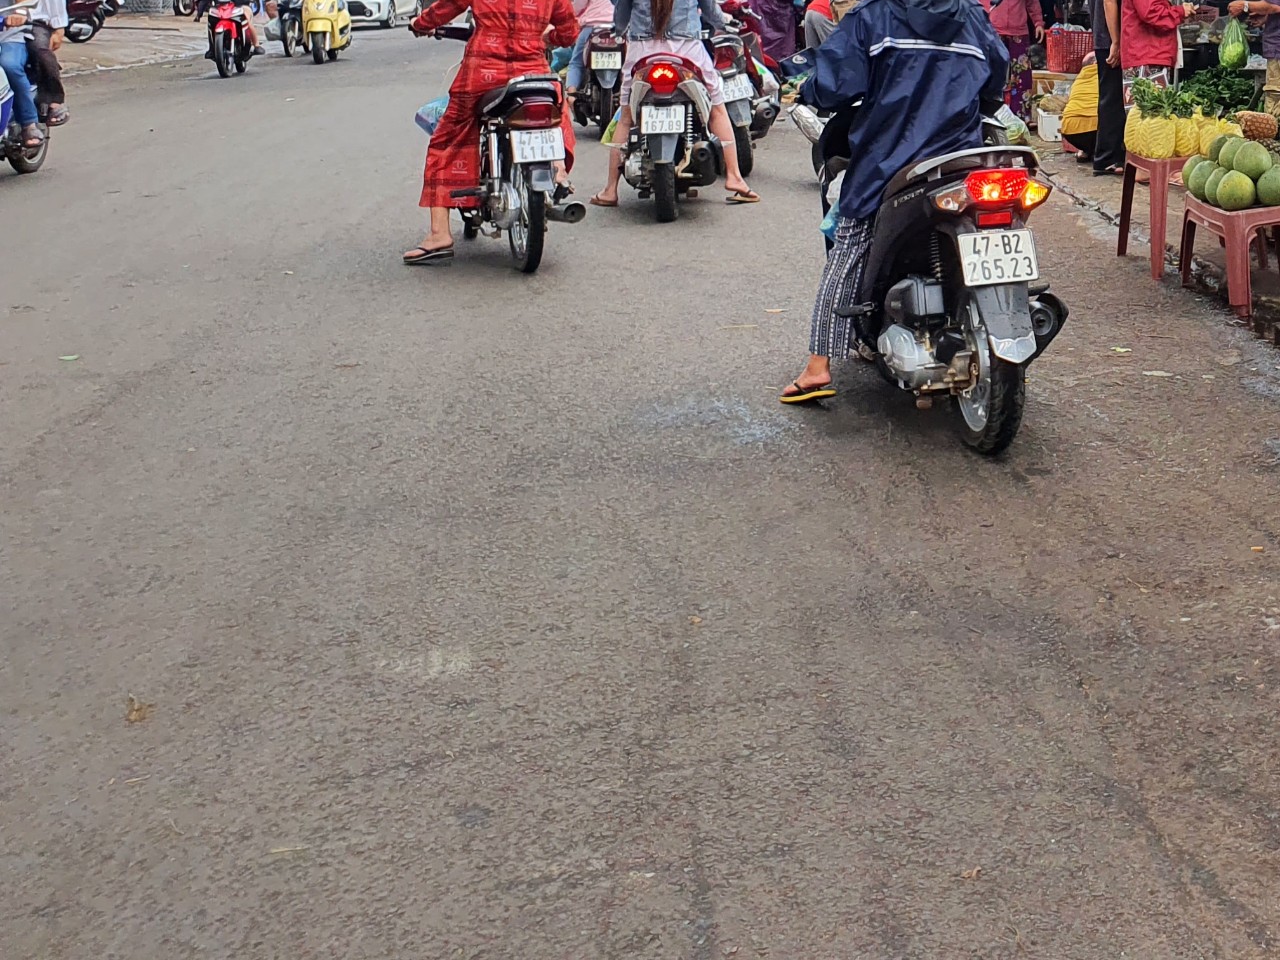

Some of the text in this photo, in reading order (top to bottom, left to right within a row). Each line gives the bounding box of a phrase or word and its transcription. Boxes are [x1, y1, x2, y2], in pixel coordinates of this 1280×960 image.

[645, 120, 682, 132] 167.89
[521, 145, 556, 160] 4141
[972, 234, 1023, 256] 47-B2
[967, 256, 1034, 283] 265.23
